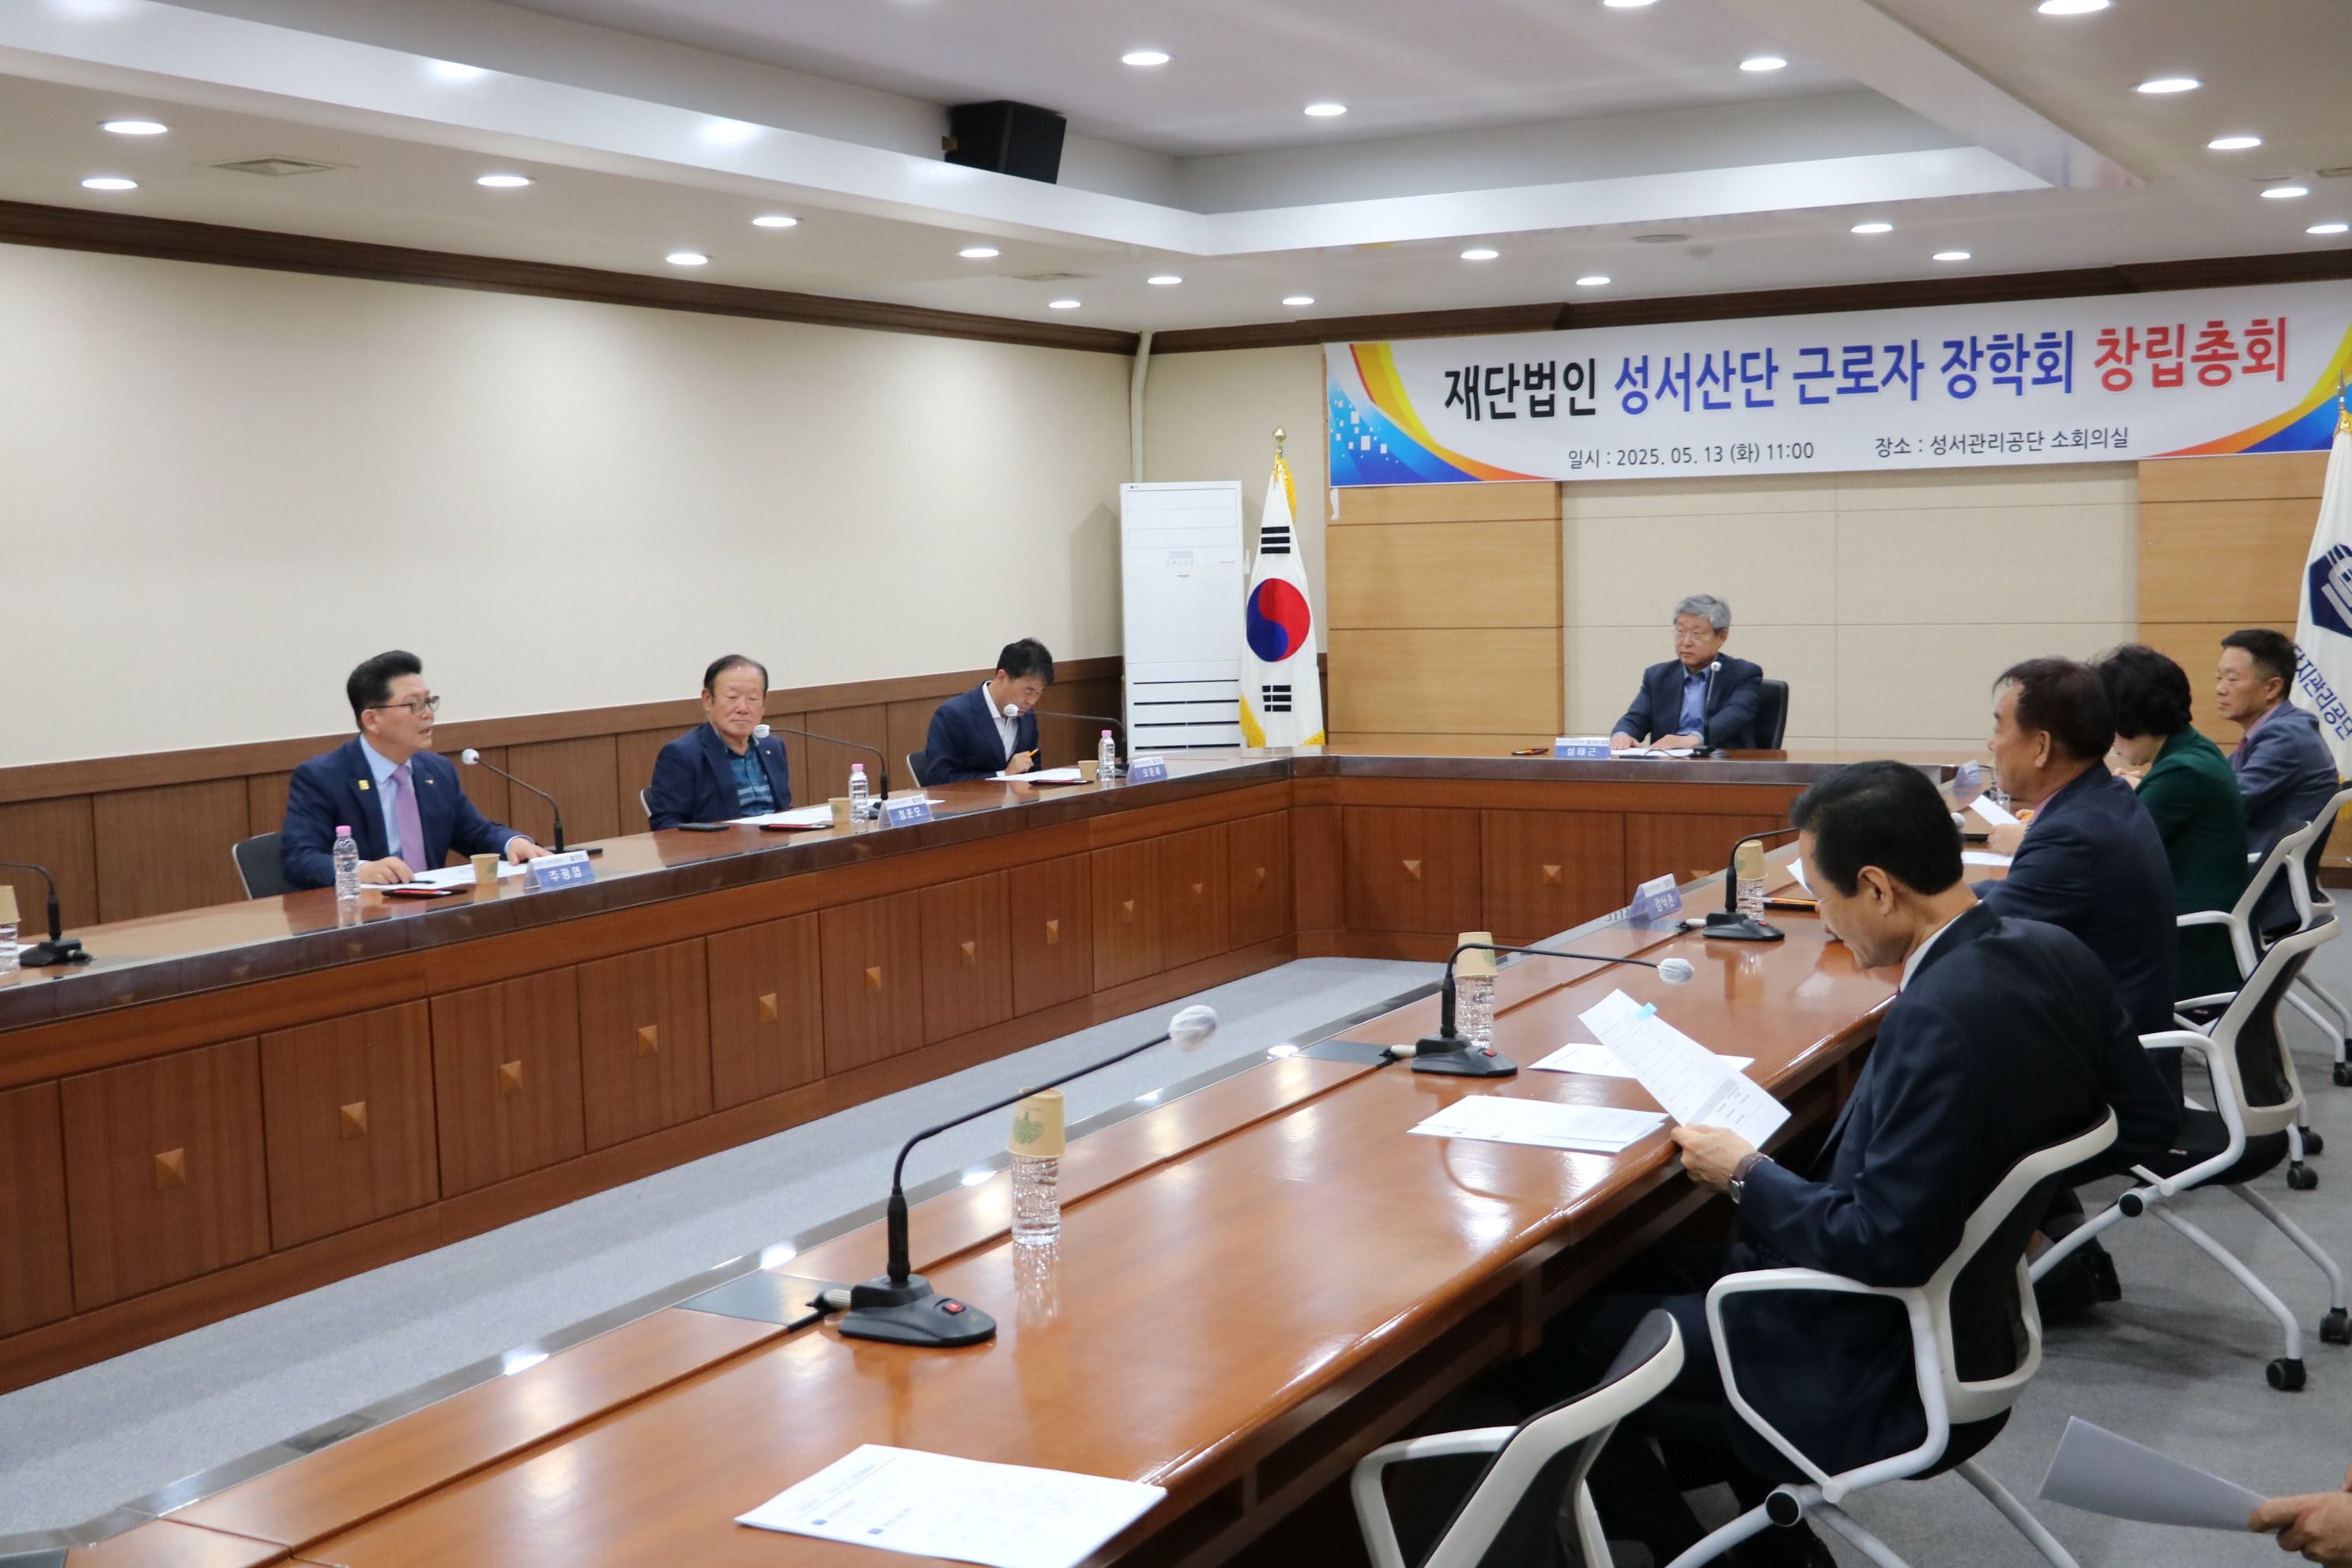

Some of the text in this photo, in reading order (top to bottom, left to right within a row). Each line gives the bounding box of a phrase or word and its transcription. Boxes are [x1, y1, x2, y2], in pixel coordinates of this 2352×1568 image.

[1444, 316, 2286, 422] 재단법인 성서산단 근로자 장학회 창립총회
[1568, 449, 1600, 469] 일시
[1616, 448, 1665, 466] 2025.
[1671, 447, 1698, 464] 05.
[1704, 445, 1724, 462] 13
[1730, 443, 1760, 464] (화)
[1766, 442, 1815, 460] 11:00
[1875, 436, 1912, 458] 장소
[1930, 430, 2045, 456] 성서관리공단
[2050, 427, 2128, 450] 소회의실
